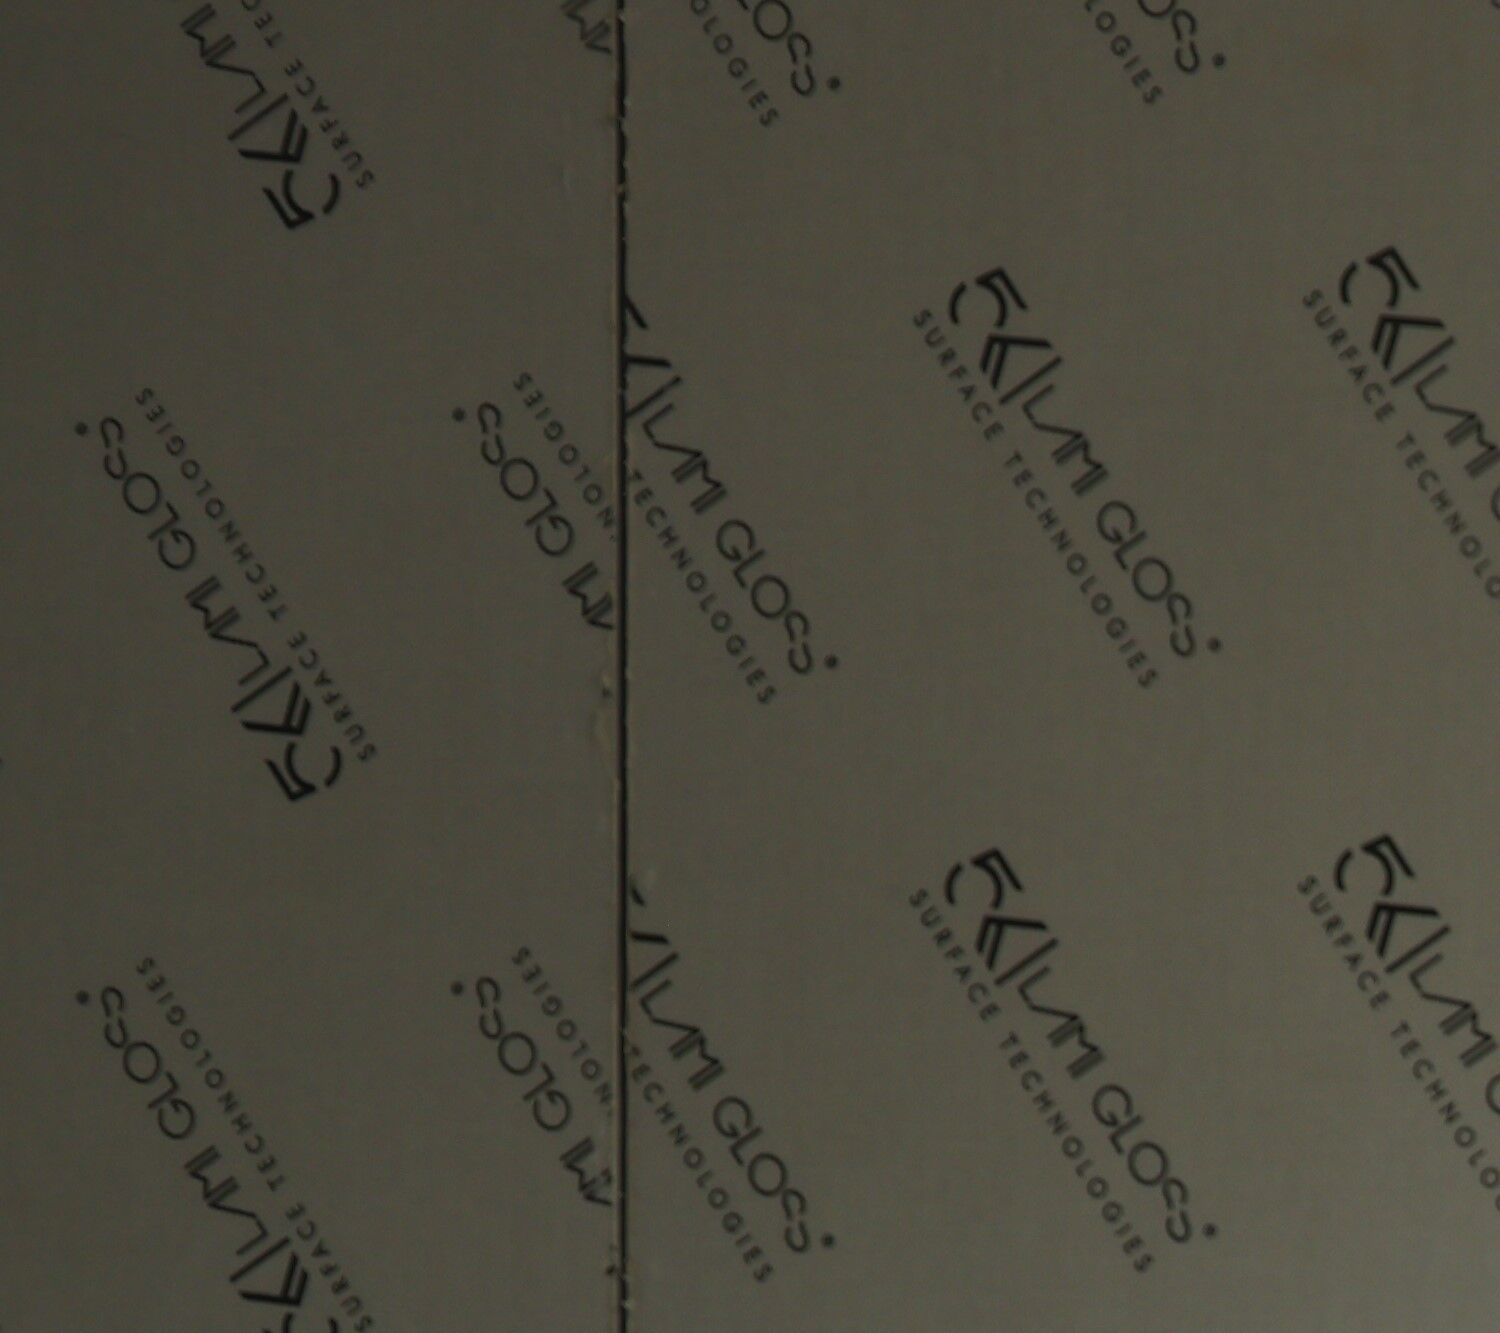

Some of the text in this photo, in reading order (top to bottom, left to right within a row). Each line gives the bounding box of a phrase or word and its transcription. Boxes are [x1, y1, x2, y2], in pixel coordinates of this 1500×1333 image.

[284, 59, 376, 189] SURFACE
[1302, 289, 1395, 422] SURFACE
[135, 388, 377, 762] SURFACE TECHNOLOGIES
[632, 469, 777, 704] TECHNOLOGIES
[913, 309, 1158, 689] SURFACE TECHNOLOGIES
[1297, 875, 1390, 1010] SURFACE
[136, 957, 374, 1333] SURFACE TECHNOLOGIES
[632, 1044, 773, 1283] TECHNOLOGIES
[909, 888, 1154, 1273] SURFACE TECHNOLOGIES
